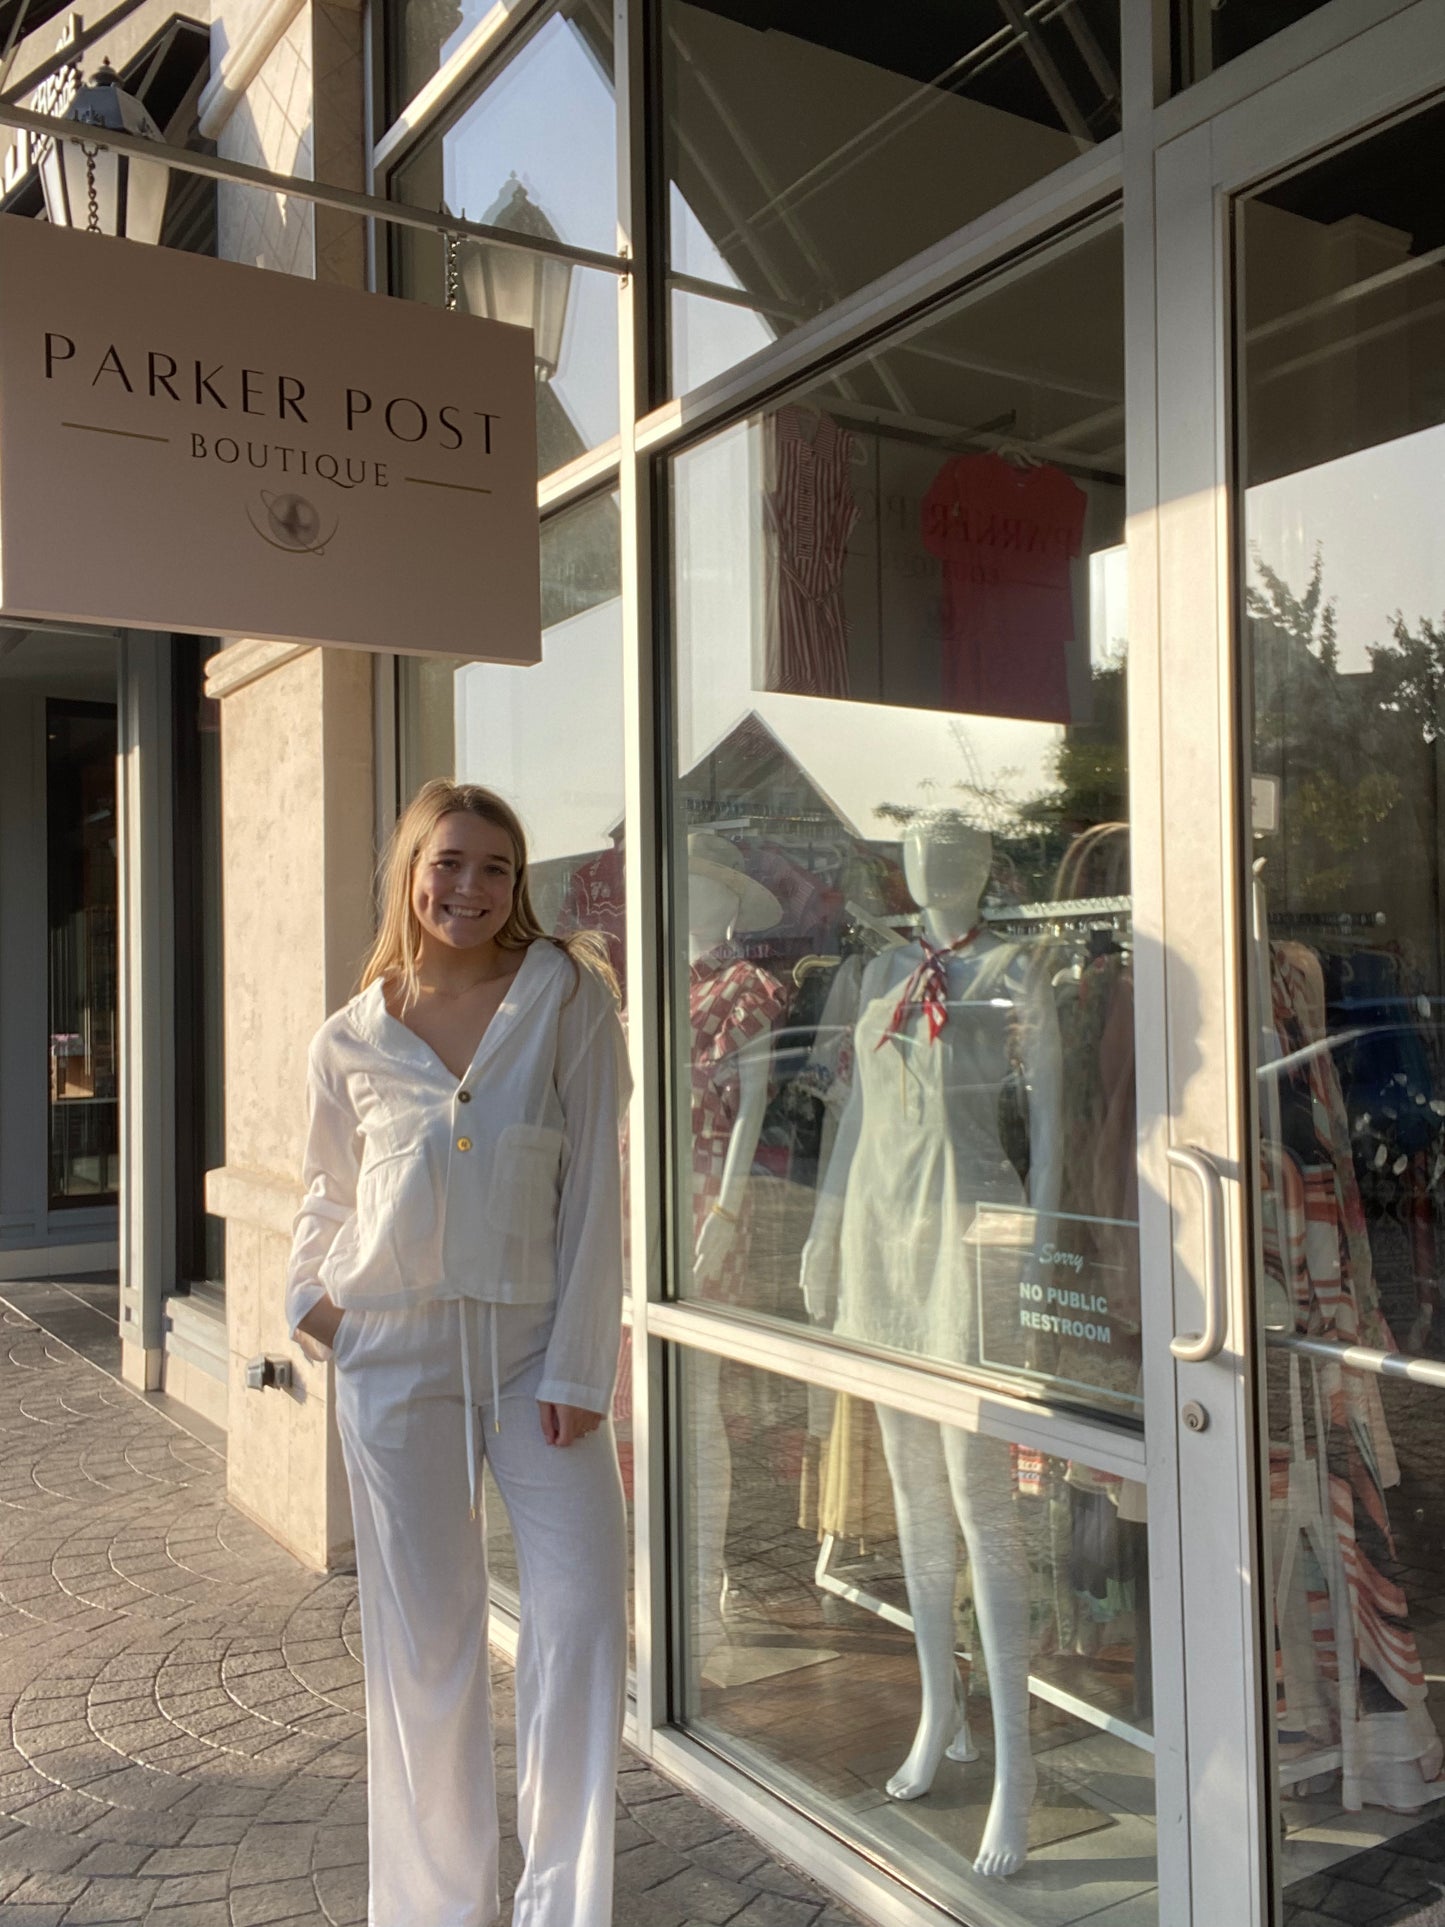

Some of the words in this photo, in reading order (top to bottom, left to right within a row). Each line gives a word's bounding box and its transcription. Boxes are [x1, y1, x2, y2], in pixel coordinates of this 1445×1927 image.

[44, 332, 309, 424] PARKER
[346, 388, 501, 454] POST
[190, 432, 389, 489] BOUTIQUE
[1039, 1243, 1084, 1273] Sorry
[1020, 1282, 1043, 1301] NO
[1047, 1287, 1108, 1314] PUBLIC
[1020, 1310, 1111, 1344] RESTROOM
